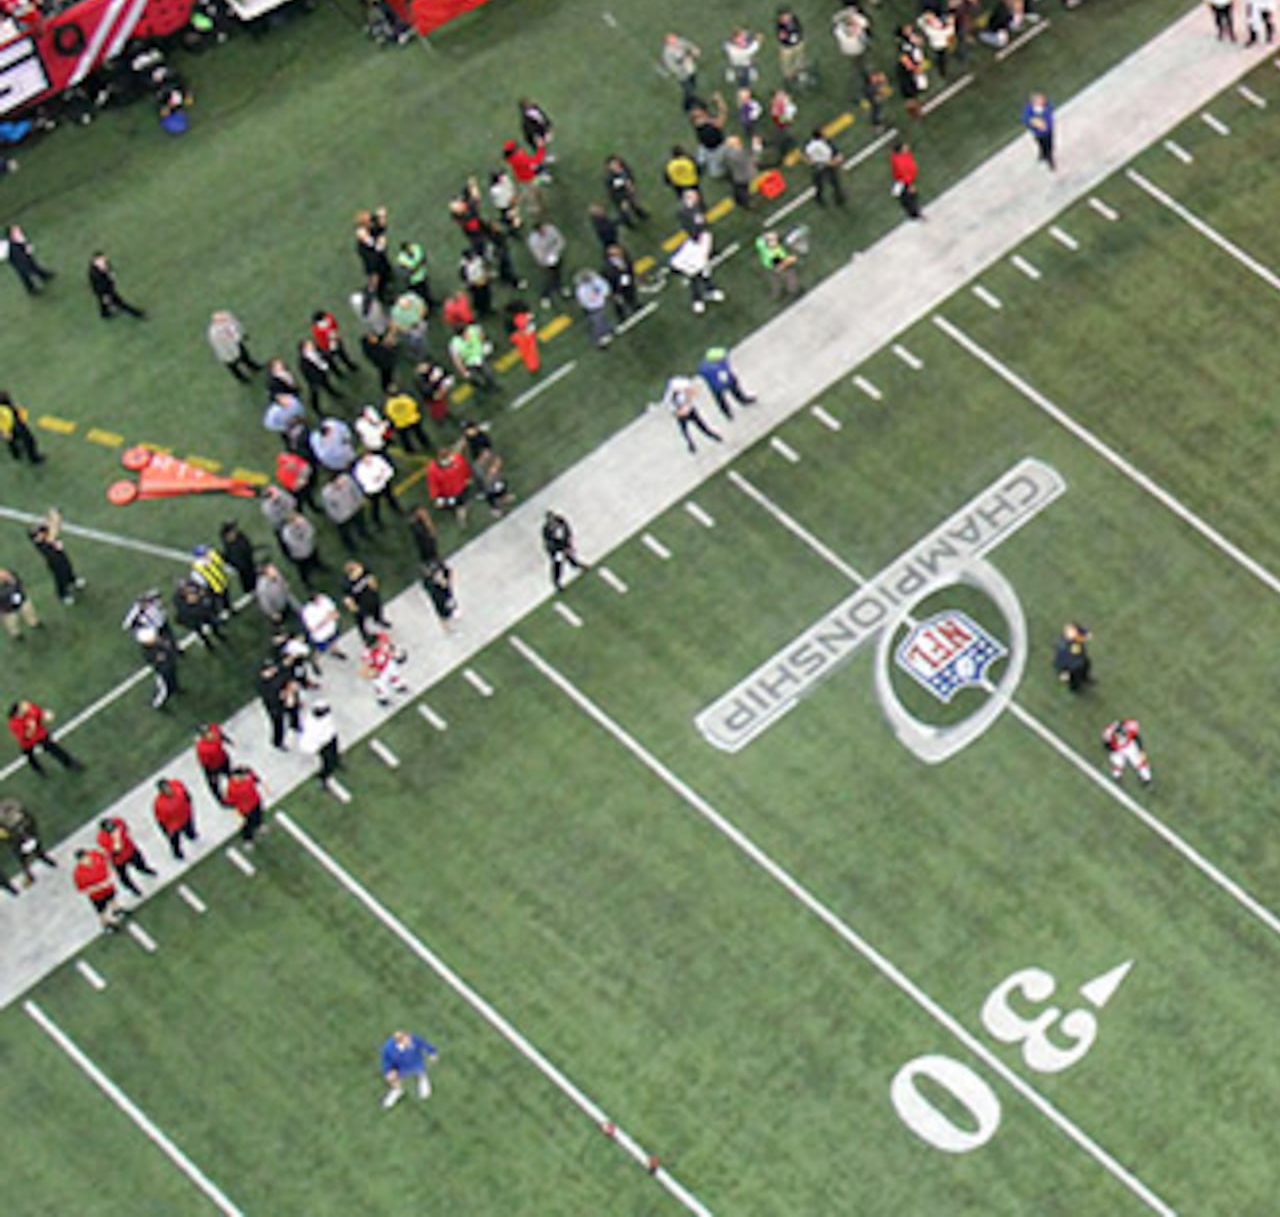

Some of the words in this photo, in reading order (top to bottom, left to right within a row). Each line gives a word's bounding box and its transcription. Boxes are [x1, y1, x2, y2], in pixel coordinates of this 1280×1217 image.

[722, 473, 1041, 733] CHAMPIONSHIP
[907, 619, 974, 668] NFL
[890, 967, 1098, 1154] 30
